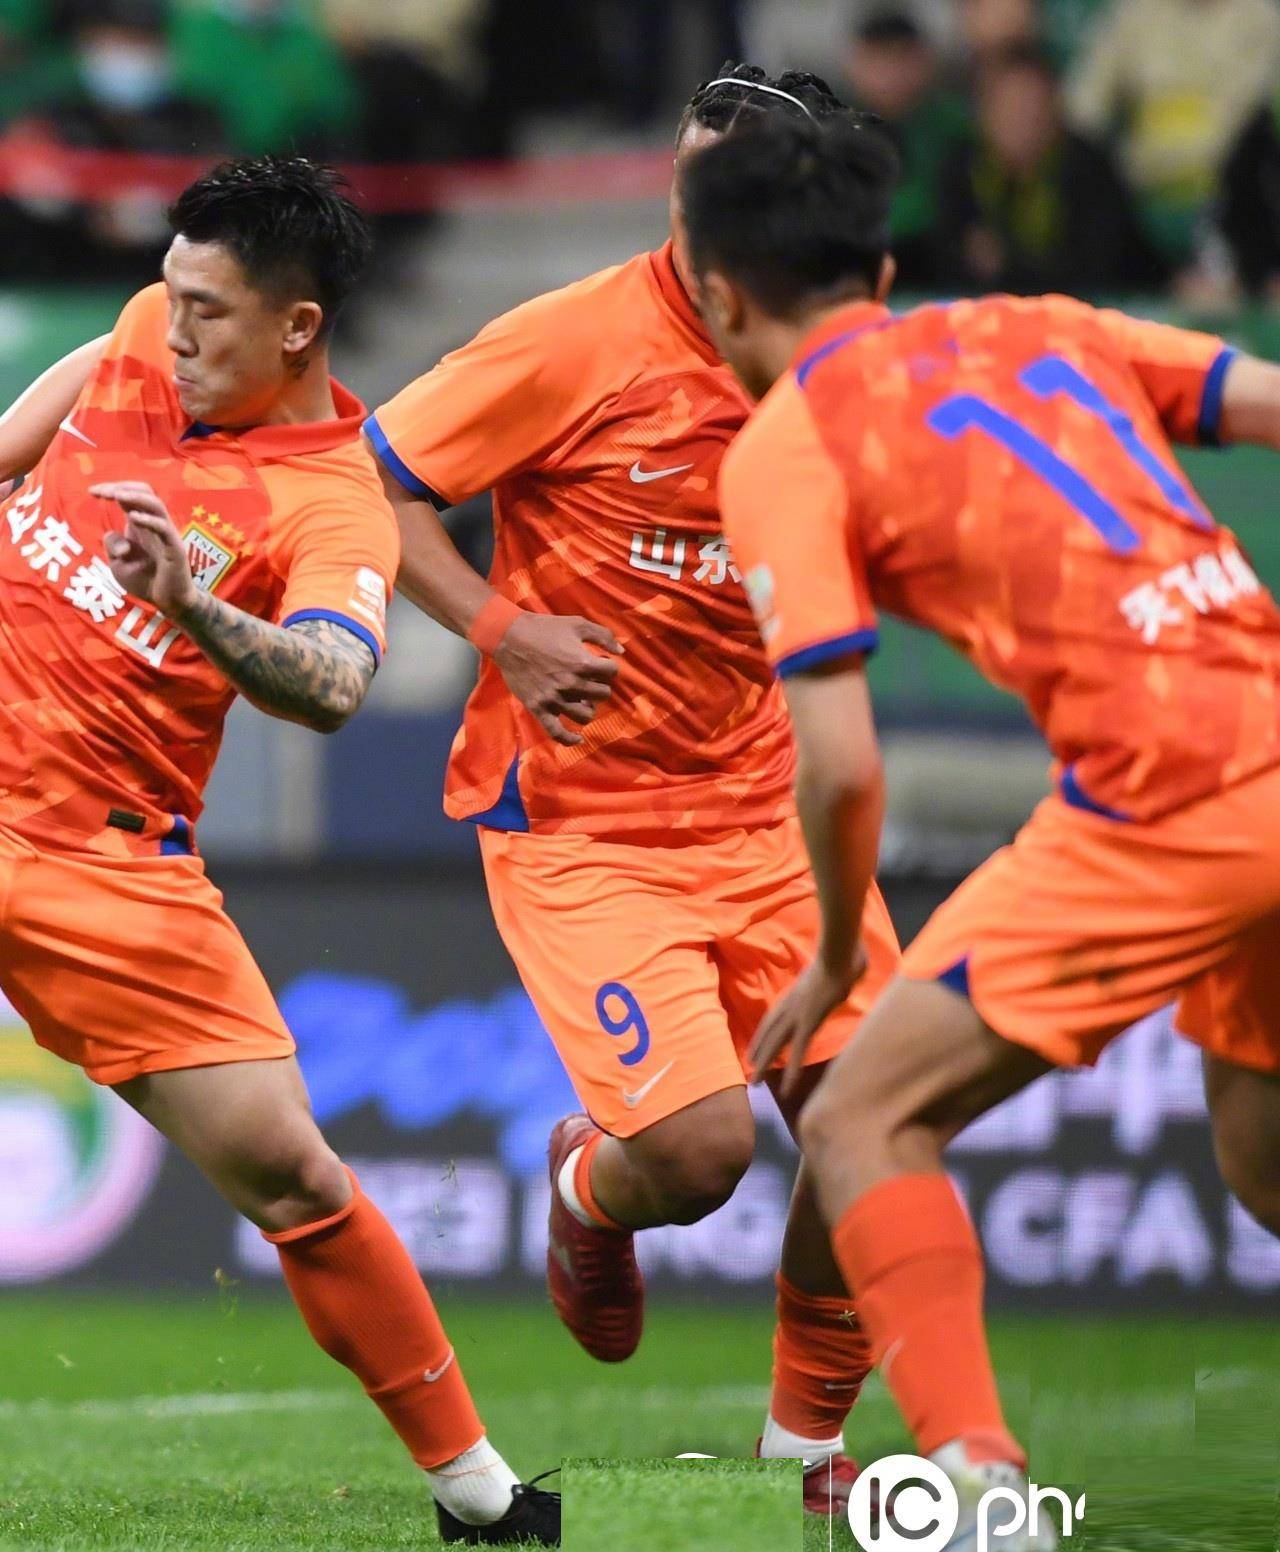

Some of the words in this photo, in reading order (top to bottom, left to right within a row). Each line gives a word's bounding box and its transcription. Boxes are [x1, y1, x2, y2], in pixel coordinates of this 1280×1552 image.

[927, 355, 1215, 554] 11
[594, 982, 651, 1067] 9
[983, 1168, 1214, 1287] CFA
